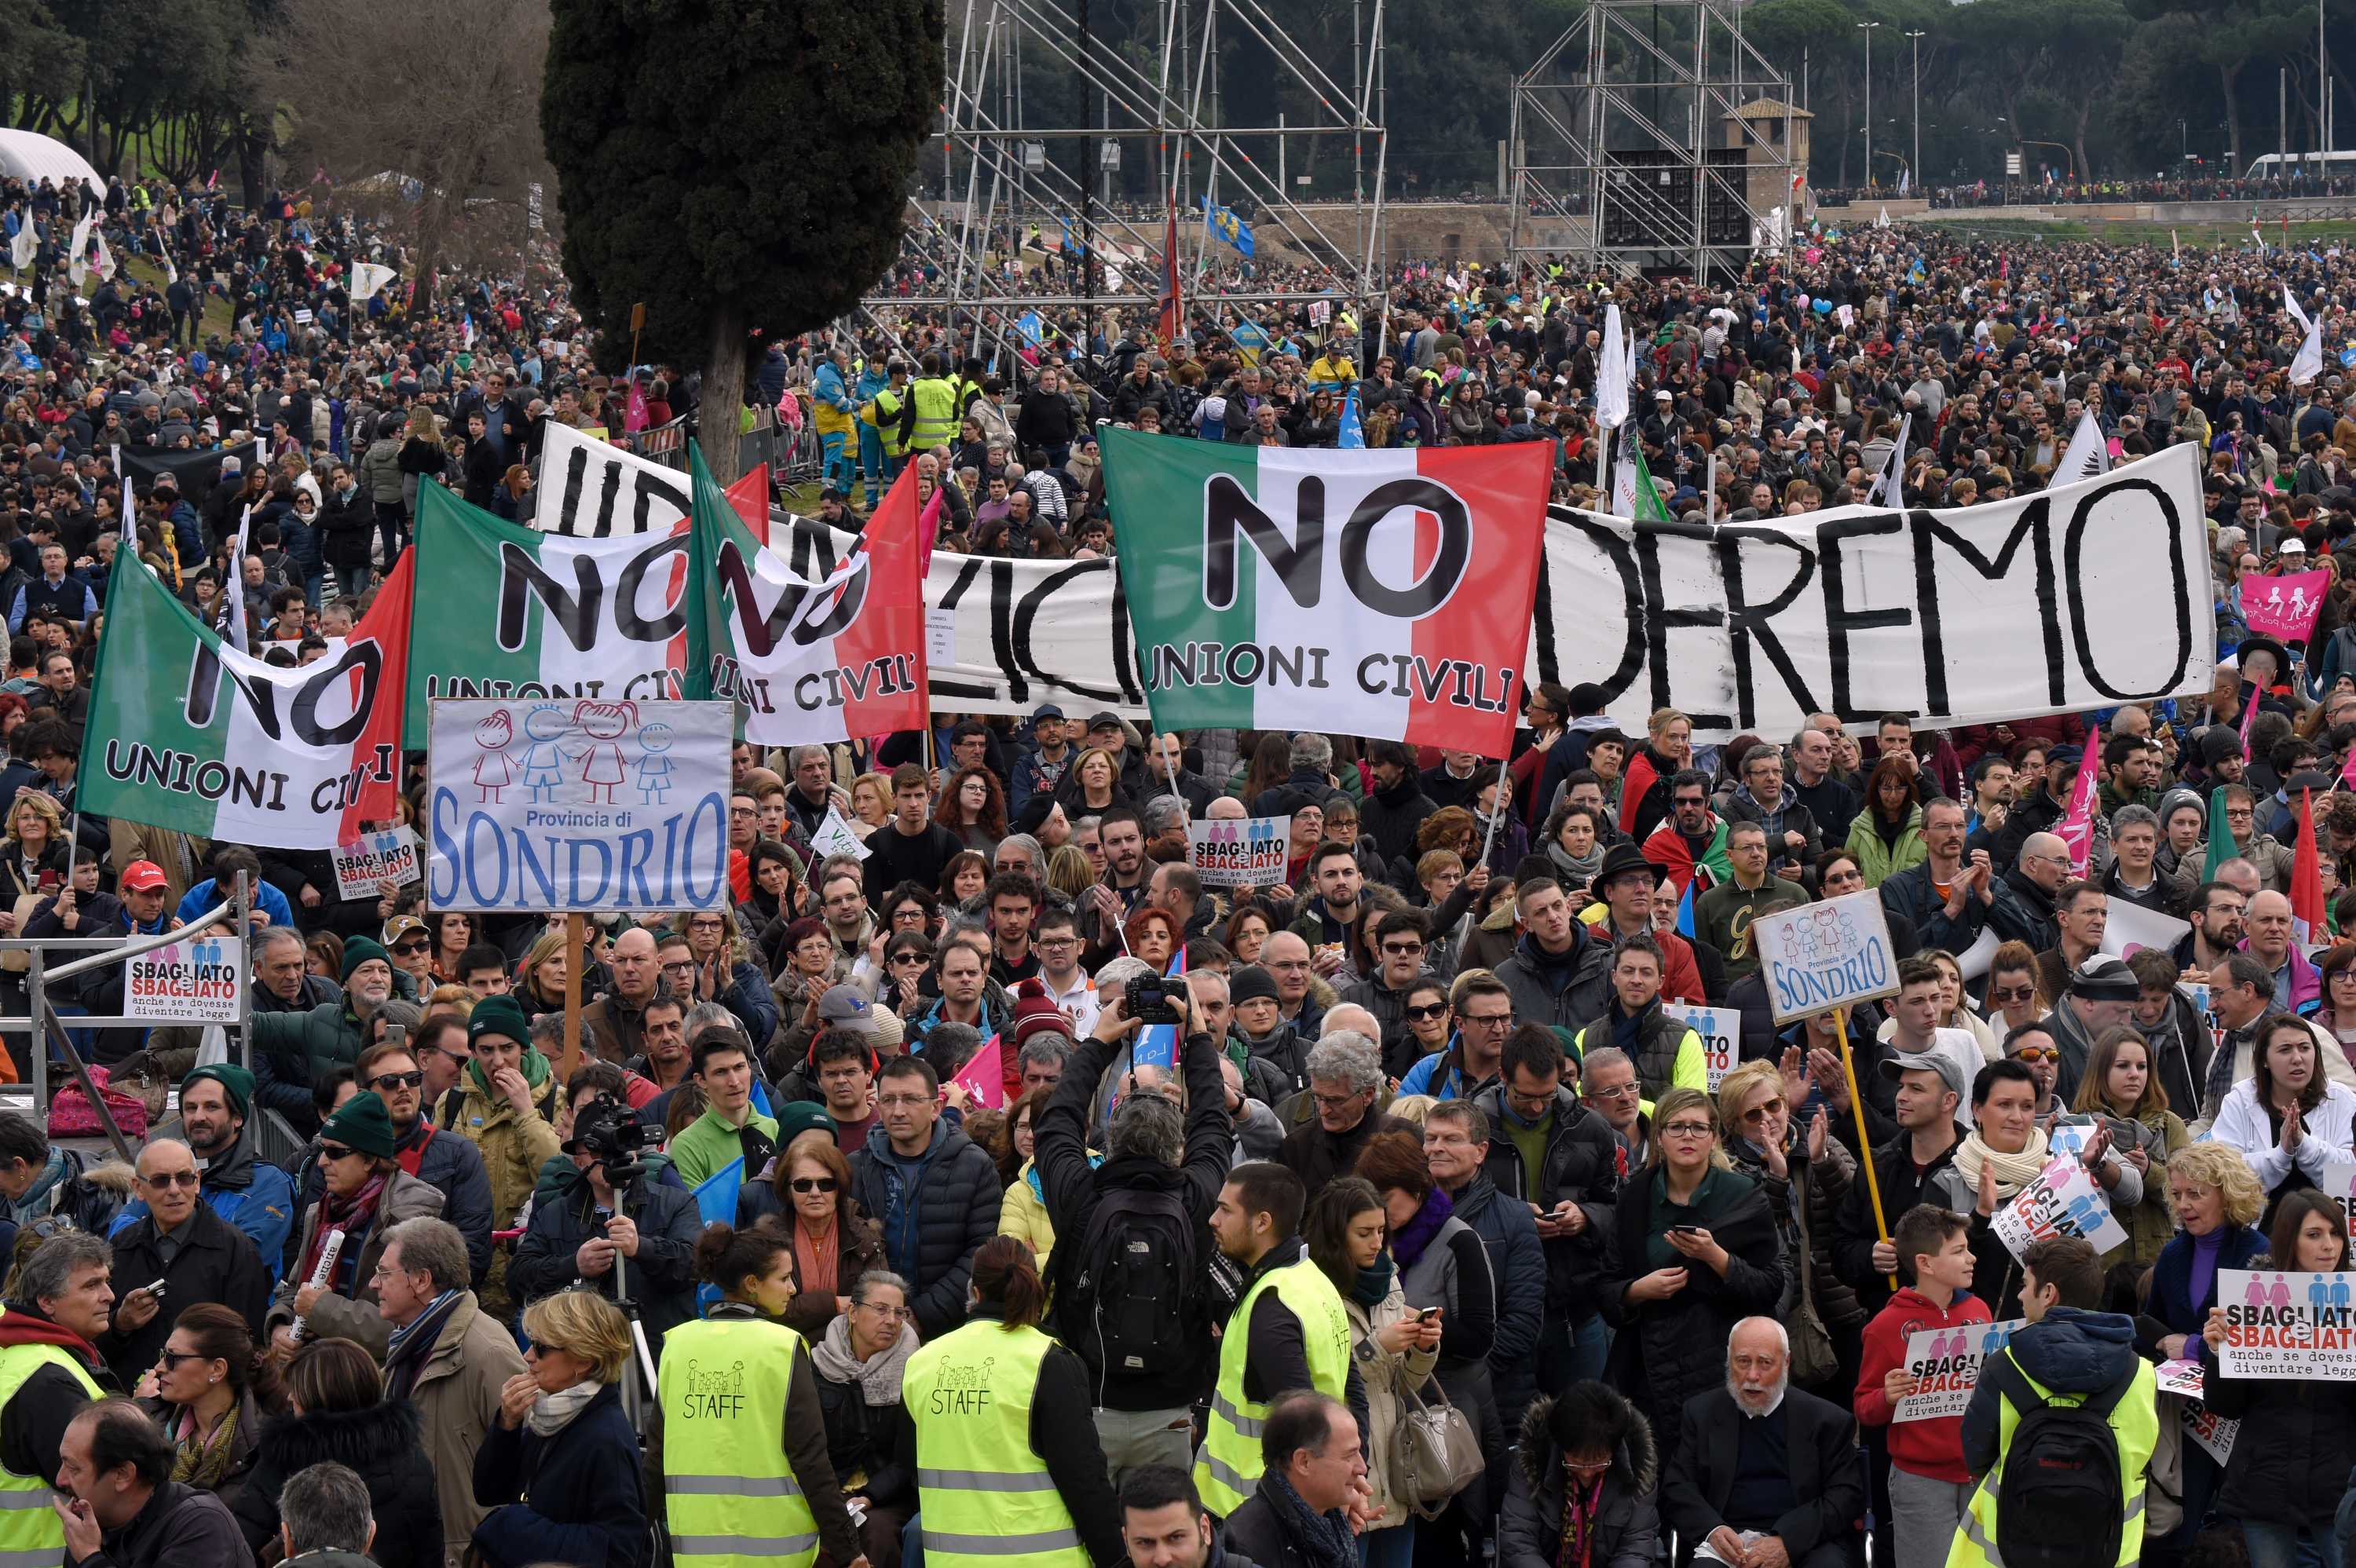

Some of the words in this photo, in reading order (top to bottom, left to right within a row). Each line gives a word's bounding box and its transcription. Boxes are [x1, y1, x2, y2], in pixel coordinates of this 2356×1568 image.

[1204, 473, 1473, 622] NO
[497, 537, 690, 653] NO
[185, 637, 384, 746] NO
[1356, 652, 1514, 715] CIVILI
[104, 738, 290, 812] UNIONI
[526, 810, 609, 828] Provincia
[615, 810, 631, 828] di
[430, 786, 727, 909] SONDRIO
[1246, 868, 1282, 878] dovesse
[132, 962, 235, 982] SBAGLIATO
[1772, 935, 1887, 1011] SONDRIO
[1808, 956, 1839, 969] Provincia
[132, 997, 164, 1006] anche
[189, 999, 234, 1008] dovesse
[134, 1007, 192, 1017] diventare
[199, 1009, 231, 1021] legge
[2226, 1304, 2356, 1329] SBAGLIAT
[2227, 1325, 2356, 1350] SBAGLIAT
[2230, 1350, 2273, 1361] anche
[2283, 1352, 2299, 1361] se
[2308, 1351, 2356, 1362] doves
[2233, 1362, 2313, 1374] diventare
[2322, 1365, 2356, 1379] legg
[682, 1394, 746, 1420] STAFF
[931, 1389, 991, 1416] STAFF
[1904, 1394, 1941, 1406] anche
[1905, 1403, 1965, 1417] diventar
